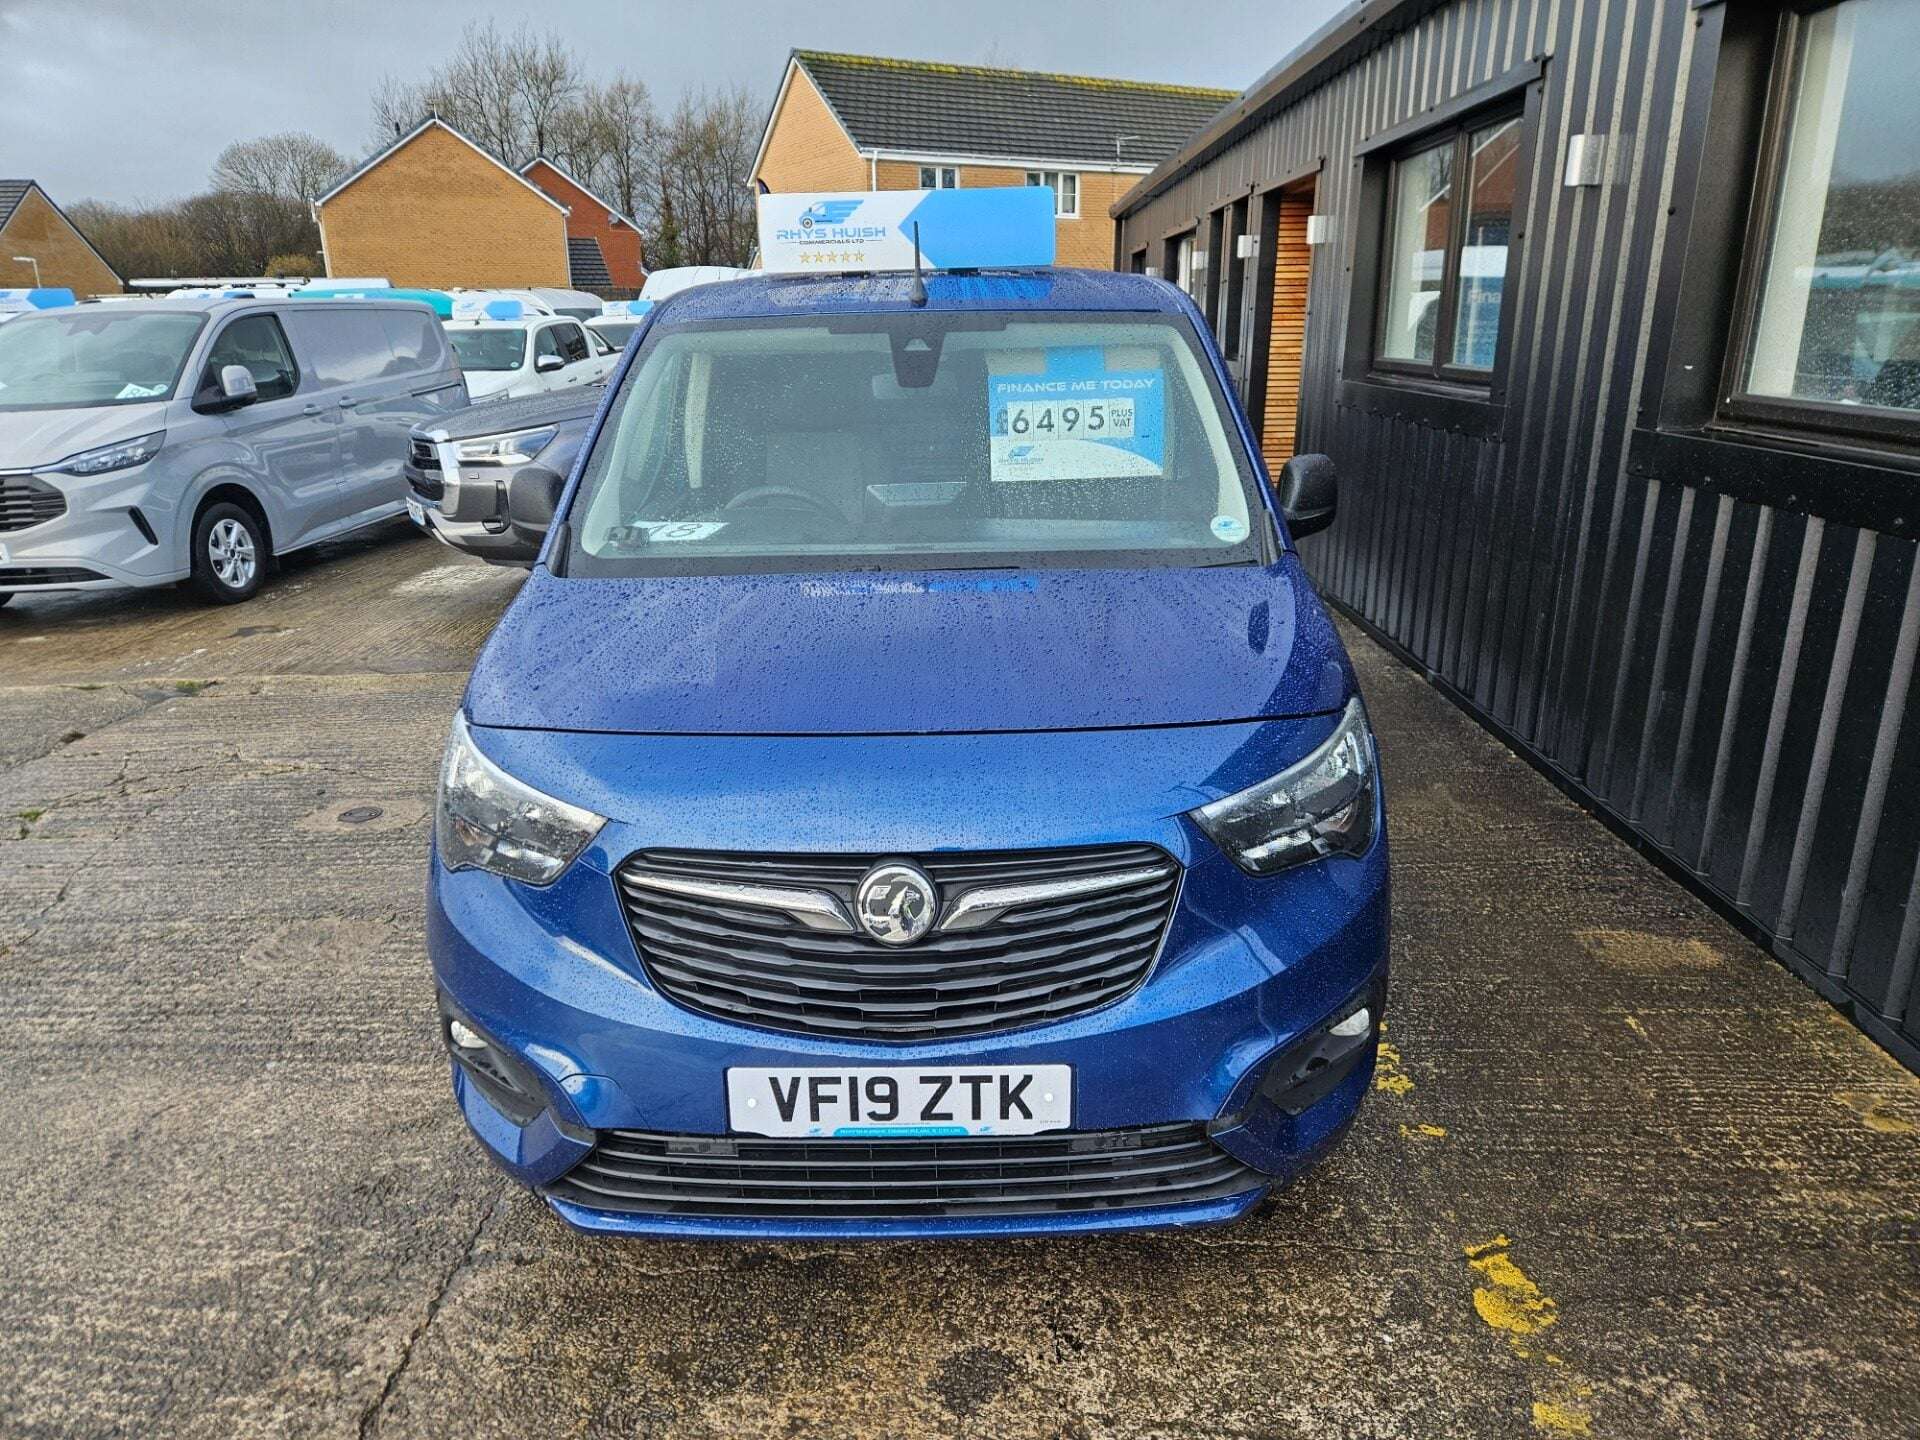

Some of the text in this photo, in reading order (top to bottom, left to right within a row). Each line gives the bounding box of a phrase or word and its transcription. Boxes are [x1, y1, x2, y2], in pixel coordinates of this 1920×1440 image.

[776, 227, 887, 240] RHYS HUISH
[996, 378, 1157, 394] FINANCE ME TODAY
[1111, 407, 1133, 418] PLUS
[1112, 418, 1132, 428] VAT
[768, 1073, 1034, 1123] VF19 ZTK
